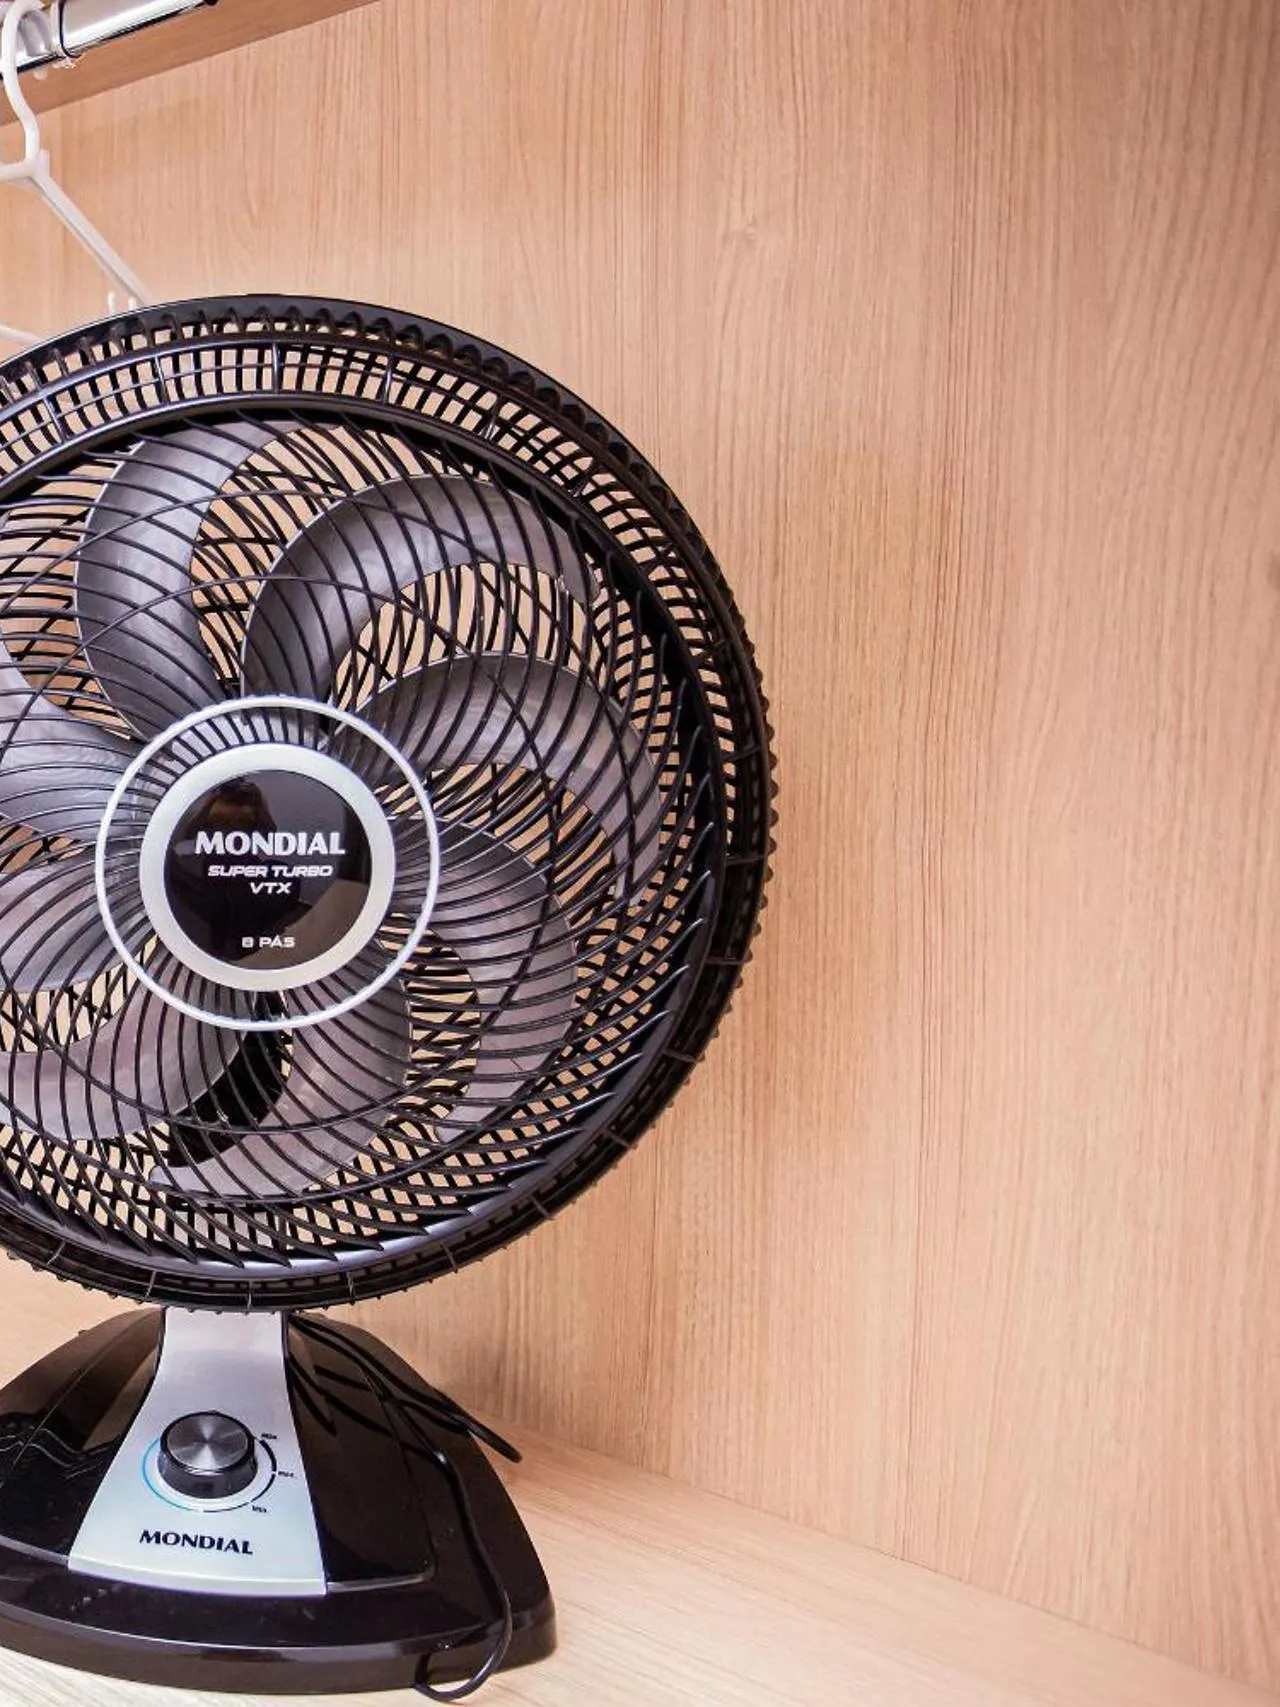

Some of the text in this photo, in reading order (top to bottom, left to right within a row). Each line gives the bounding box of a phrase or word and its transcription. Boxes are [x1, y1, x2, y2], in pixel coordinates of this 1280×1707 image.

[194, 831, 346, 856] MONDIAL
[207, 865, 334, 878] SUPER TURBO
[249, 882, 293, 895] VTX
[139, 1529, 254, 1556] MONDIAL
